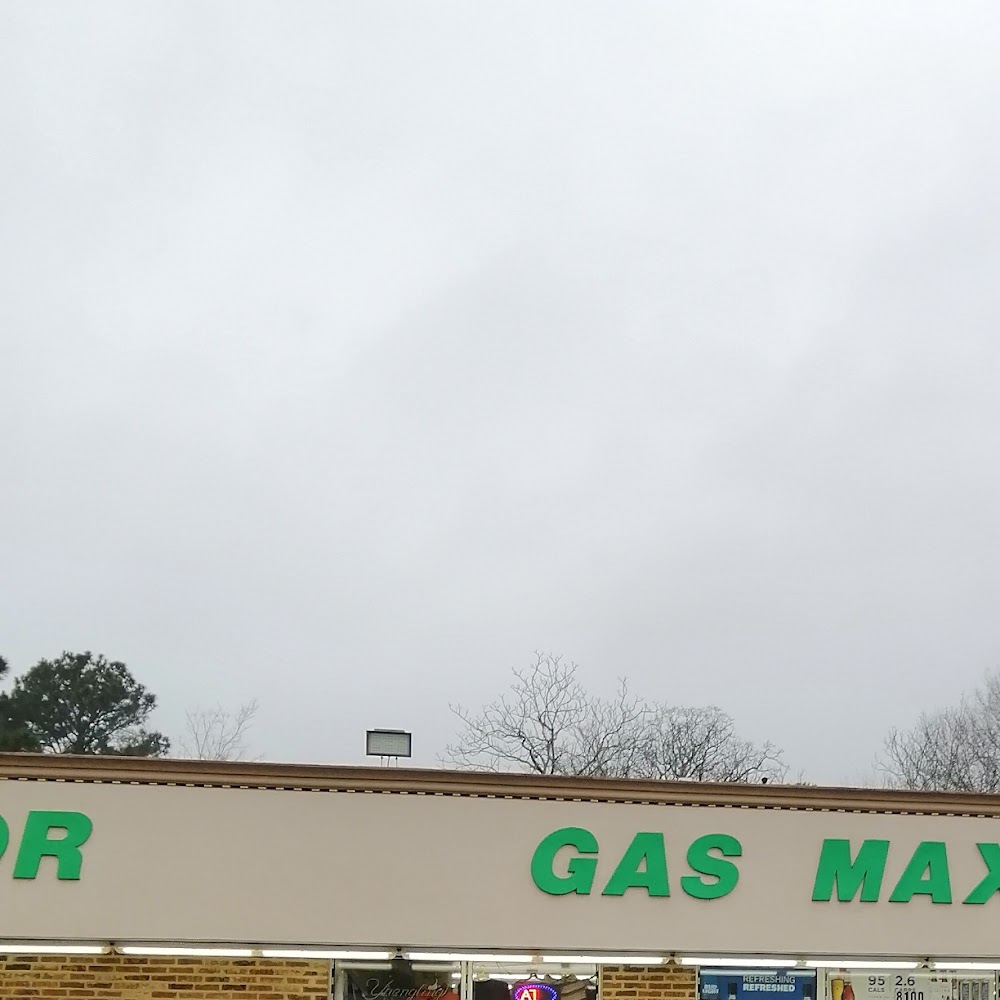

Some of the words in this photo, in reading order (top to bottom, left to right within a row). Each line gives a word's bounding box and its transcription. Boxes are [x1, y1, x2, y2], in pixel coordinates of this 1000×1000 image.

[0, 811, 93, 880] R
[530, 827, 743, 900] GAS
[742, 975, 796, 984] REFRESHING
[868, 976, 885, 986] 95
[895, 976, 915, 986] 2.6
[742, 983, 796, 992] REFRESHED
